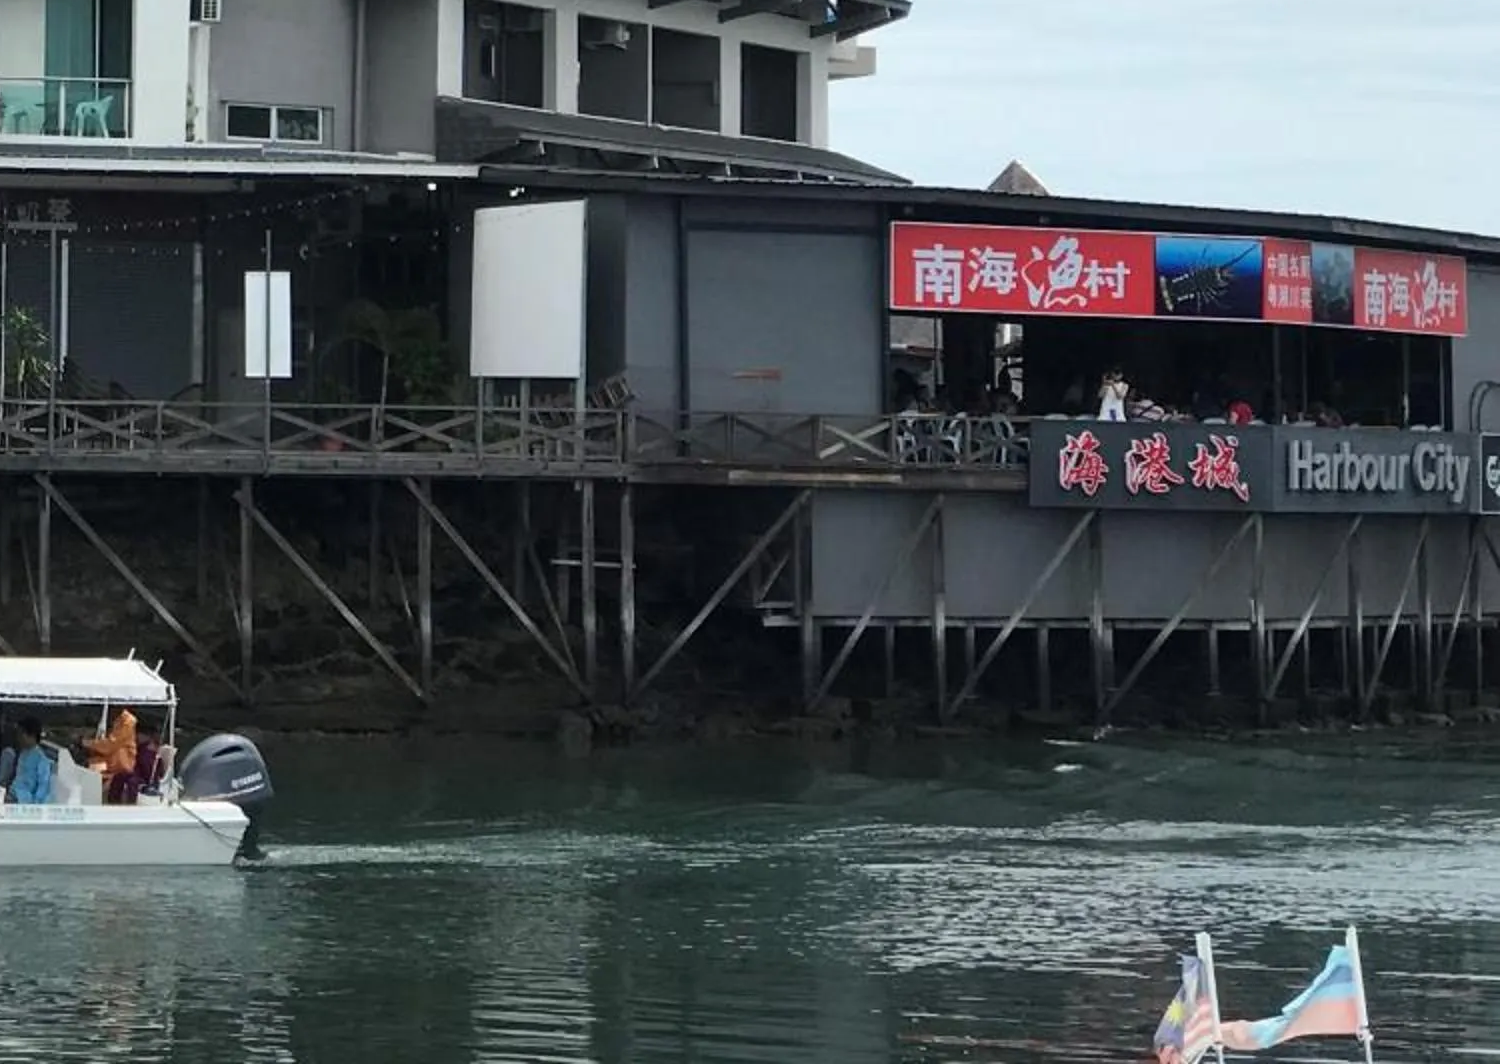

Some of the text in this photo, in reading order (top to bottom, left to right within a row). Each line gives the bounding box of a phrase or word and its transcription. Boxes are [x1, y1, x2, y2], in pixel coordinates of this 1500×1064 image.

[1059, 429, 1250, 502] 海港城
[1287, 439, 1410, 492] Harbour
[1412, 440, 1471, 504] City
